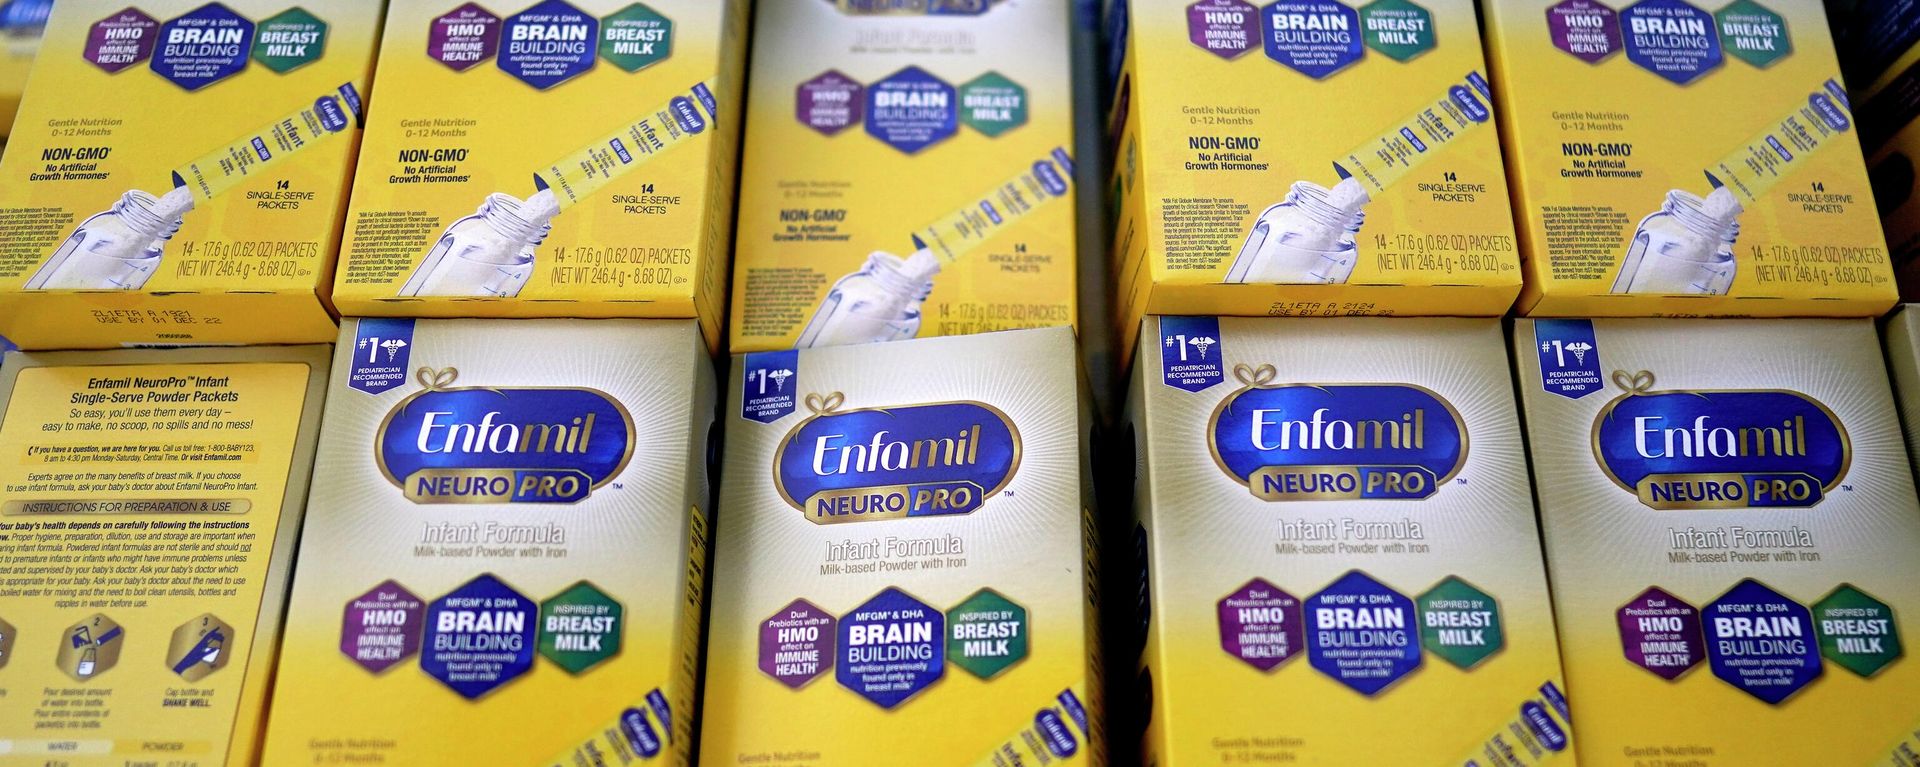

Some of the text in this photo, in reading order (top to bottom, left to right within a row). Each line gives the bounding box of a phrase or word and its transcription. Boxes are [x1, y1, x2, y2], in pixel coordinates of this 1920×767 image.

[1272, 15, 1348, 30] BRAIN
[1367, 18, 1424, 31] BREAST
[1631, 18, 1705, 35] BRAIN
[105, 28, 142, 39] HMO
[168, 29, 244, 43] BRAIN
[447, 24, 485, 36] HMO
[512, 25, 588, 40] BRAIN
[606, 29, 666, 41] BREAST
[1274, 31, 1351, 43] BUILDING
[1723, 24, 1780, 37] BREAST
[260, 33, 319, 43] BREAST
[1379, 32, 1418, 45] MILK
[1635, 35, 1709, 49] BUILDING
[1736, 37, 1774, 51] MILK
[164, 45, 238, 56] BUILDING
[266, 45, 305, 56] MILK
[510, 42, 585, 54] BUILDING
[613, 42, 653, 55] MILK
[401, 118, 476, 128] Gentle Nutrition
[406, 128, 466, 138] 0-12 Months
[45, 163, 96, 172] No Artificial
[403, 165, 456, 174] No Artificial
[276, 180, 289, 189] 14
[1443, 173, 1456, 182] 14
[641, 184, 654, 193] 14
[1418, 183, 1486, 192] SINGLE-SERVE
[1811, 182, 1824, 192] 14
[246, 191, 314, 200] SINGLE-SERVE
[612, 194, 680, 204] SINGLE-SERVE
[1432, 193, 1474, 202] PACKETS
[1788, 194, 1853, 203] SINGLE-SERVE
[258, 201, 299, 210] PACKETS
[624, 205, 666, 214] PACKETS
[1802, 203, 1843, 214] PACKETS
[182, 242, 317, 258] 14 17.6 (0.62 OZ) PACKETS
[551, 267, 672, 286] (NET WT 246.4 8.68 OZ)
[88, 378, 130, 389] Enfamil
[195, 377, 229, 387] Infant
[353, 373, 403, 381] RECOMMENDED
[1546, 377, 1599, 385] RECOMMENDED
[71, 391, 239, 405] Single-Serve Powder Packets
[749, 395, 790, 406] PEDIATRICIAN
[70, 409, 81, 418] So
[84, 409, 106, 419] easy,
[108, 408, 132, 419] you'll
[153, 408, 176, 417] them
[179, 409, 203, 418] every
[206, 408, 222, 418] day
[745, 401, 793, 412] RECOMMENDED
[758, 409, 779, 417] BRAND
[42, 423, 63, 432] easy
[76, 421, 103, 432] make,
[120, 423, 149, 432] scoop,
[166, 420, 189, 431] spills
[192, 420, 209, 429] and
[225, 420, 254, 429] mess!
[417, 411, 596, 454] Enfamil
[1252, 408, 1423, 450] Enfamil
[1634, 416, 1805, 458] Enfamil
[812, 425, 980, 476] Enfamil
[28, 473, 52, 481] Experts
[98, 473, 116, 481] many
[118, 472, 145, 480] benefits
[155, 472, 176, 480] breast
[203, 473, 215, 481] you
[1263, 473, 1425, 494] NEURO PRO
[418, 476, 579, 497] NEURO PRO
[1651, 480, 1810, 501] NEURO PRO
[22, 502, 230, 512] INSTRUCTIONS FOR PREPARATION USE
[818, 488, 971, 517] NEURO PRO
[422, 522, 564, 544] Infant Formula
[1278, 519, 1422, 541] Infant Formula
[1669, 526, 1812, 548] Infant Formula
[825, 534, 962, 562] Infant Formula
[362, 610, 407, 626] HMO
[436, 611, 525, 633] BRAIN
[1238, 608, 1284, 623] HMO
[1316, 608, 1404, 629] BRAIN
[1425, 612, 1491, 627] BREAST
[546, 616, 615, 633] BREAST
[953, 622, 1019, 639] BREAST
[1638, 617, 1683, 631] HMO
[1714, 617, 1802, 638] BRAIN
[1822, 619, 1888, 635] BREAST
[778, 628, 819, 643] HMO
[849, 622, 932, 645] BRAIN
[1318, 631, 1407, 648] BUILDING
[1438, 630, 1485, 646] MILK
[434, 635, 523, 651] BUILDING
[554, 634, 602, 651] MILK
[964, 641, 1009, 657] MILK
[1719, 640, 1806, 656] BUILDING
[1837, 638, 1883, 654] MILK
[849, 644, 932, 662] BUILDING
